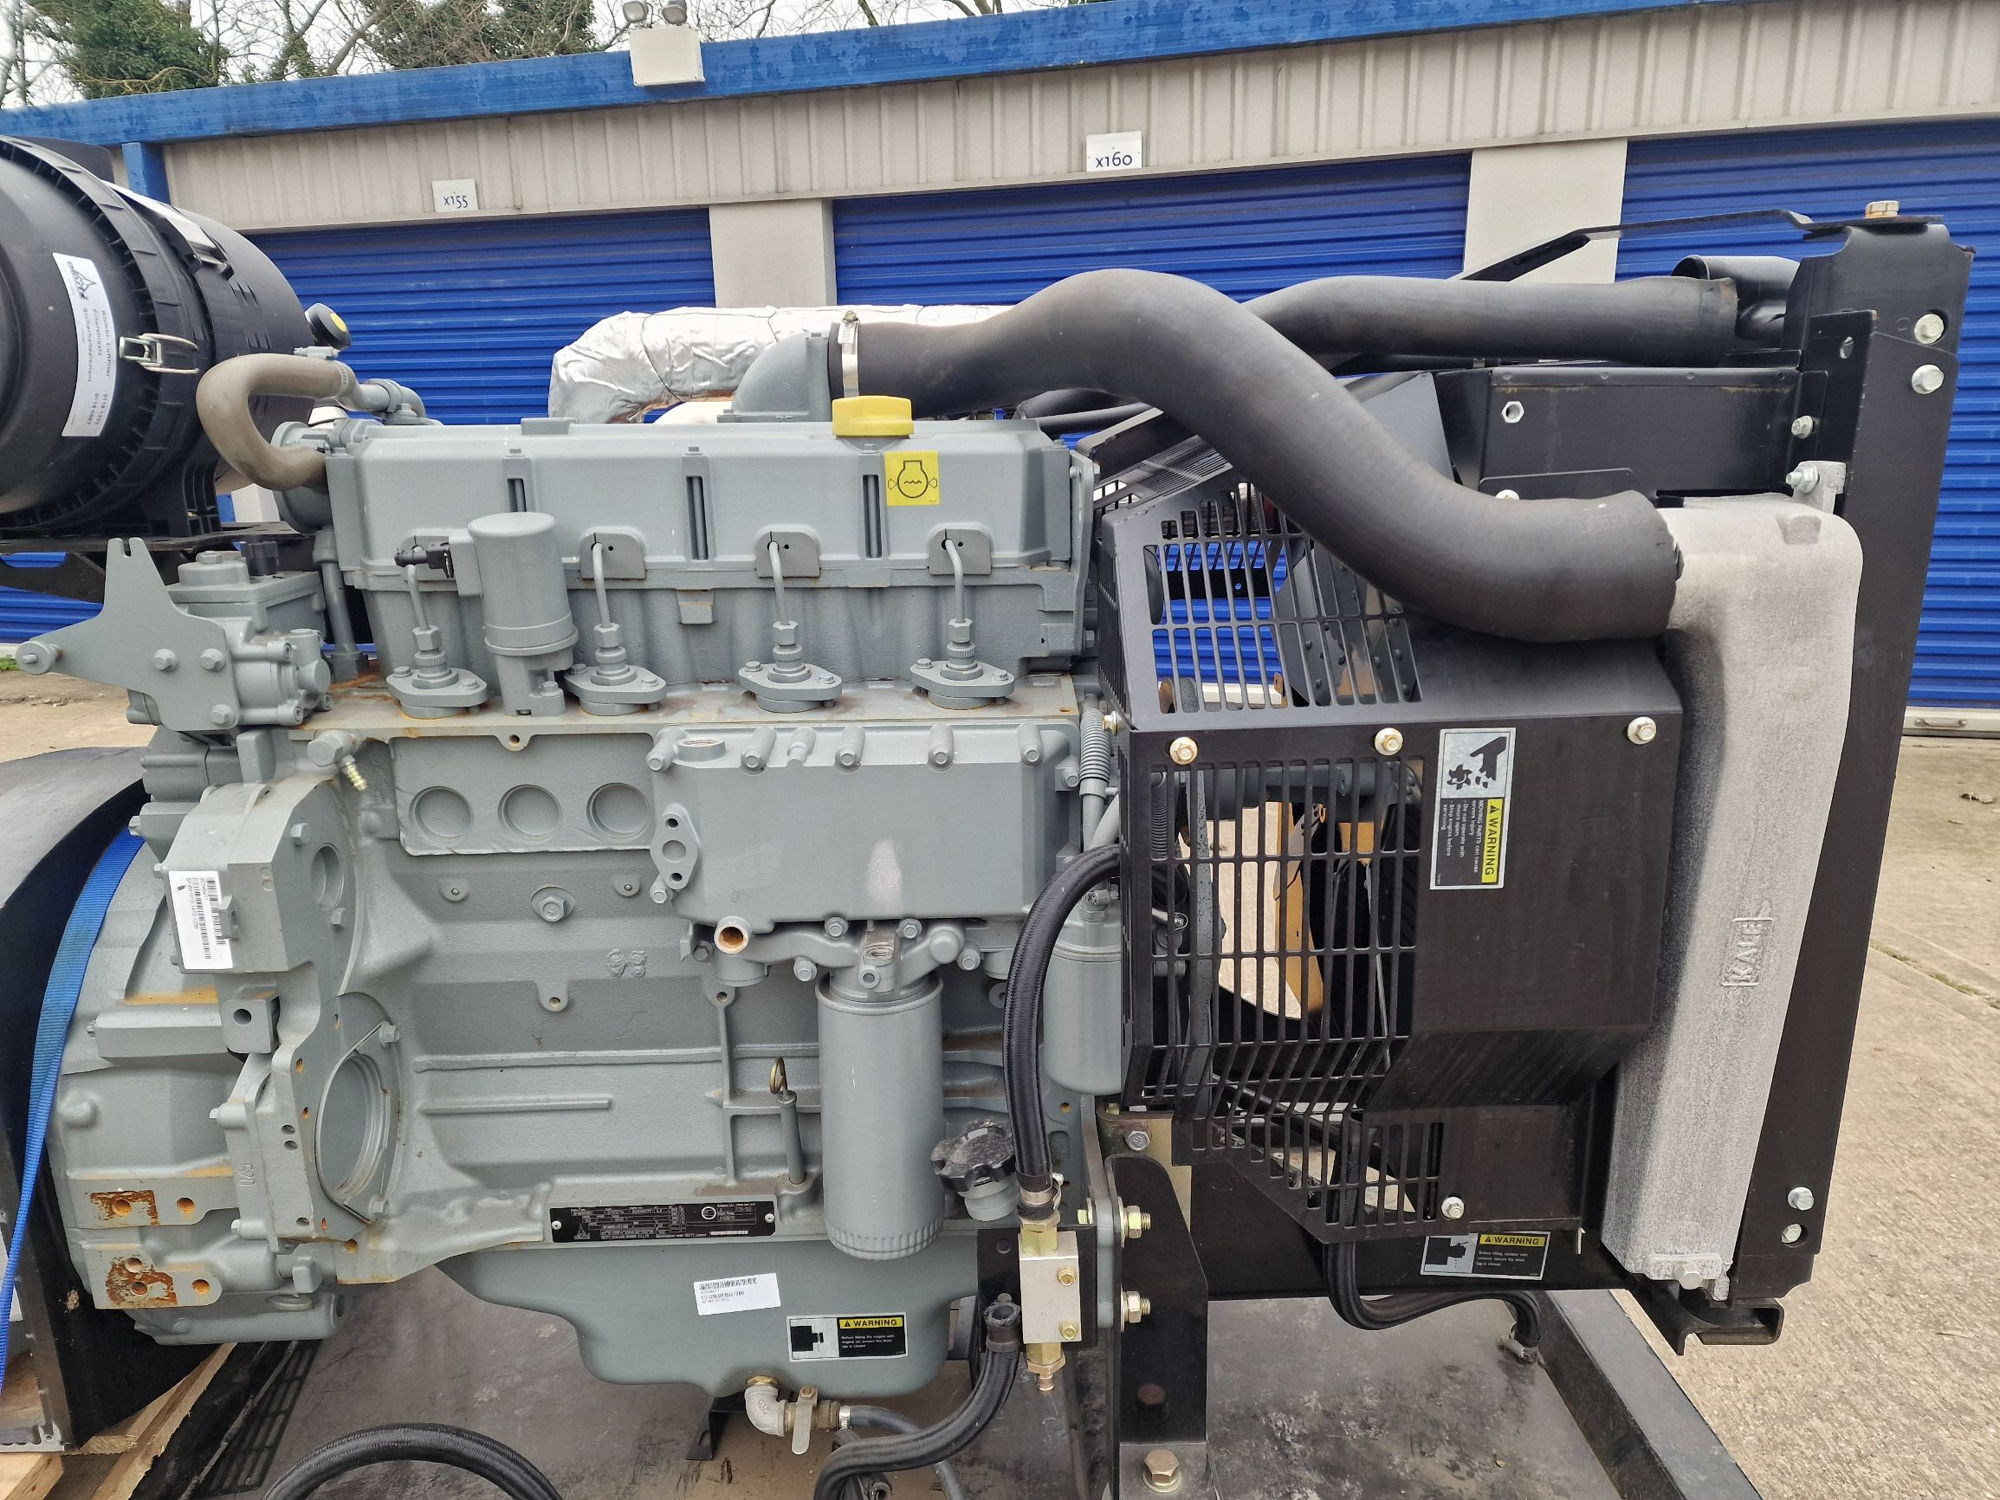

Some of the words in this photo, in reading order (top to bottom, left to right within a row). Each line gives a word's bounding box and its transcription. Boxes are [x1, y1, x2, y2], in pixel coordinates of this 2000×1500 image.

[1095, 151, 1132, 168] x160
[443, 195, 468, 209] x155
[1477, 800, 1485, 824] MOVING
[1475, 824, 1483, 843] PARTS
[1485, 817, 1500, 876] WARNING
[1494, 1236, 1539, 1246] WARNING
[853, 1319, 897, 1327] WARNING
